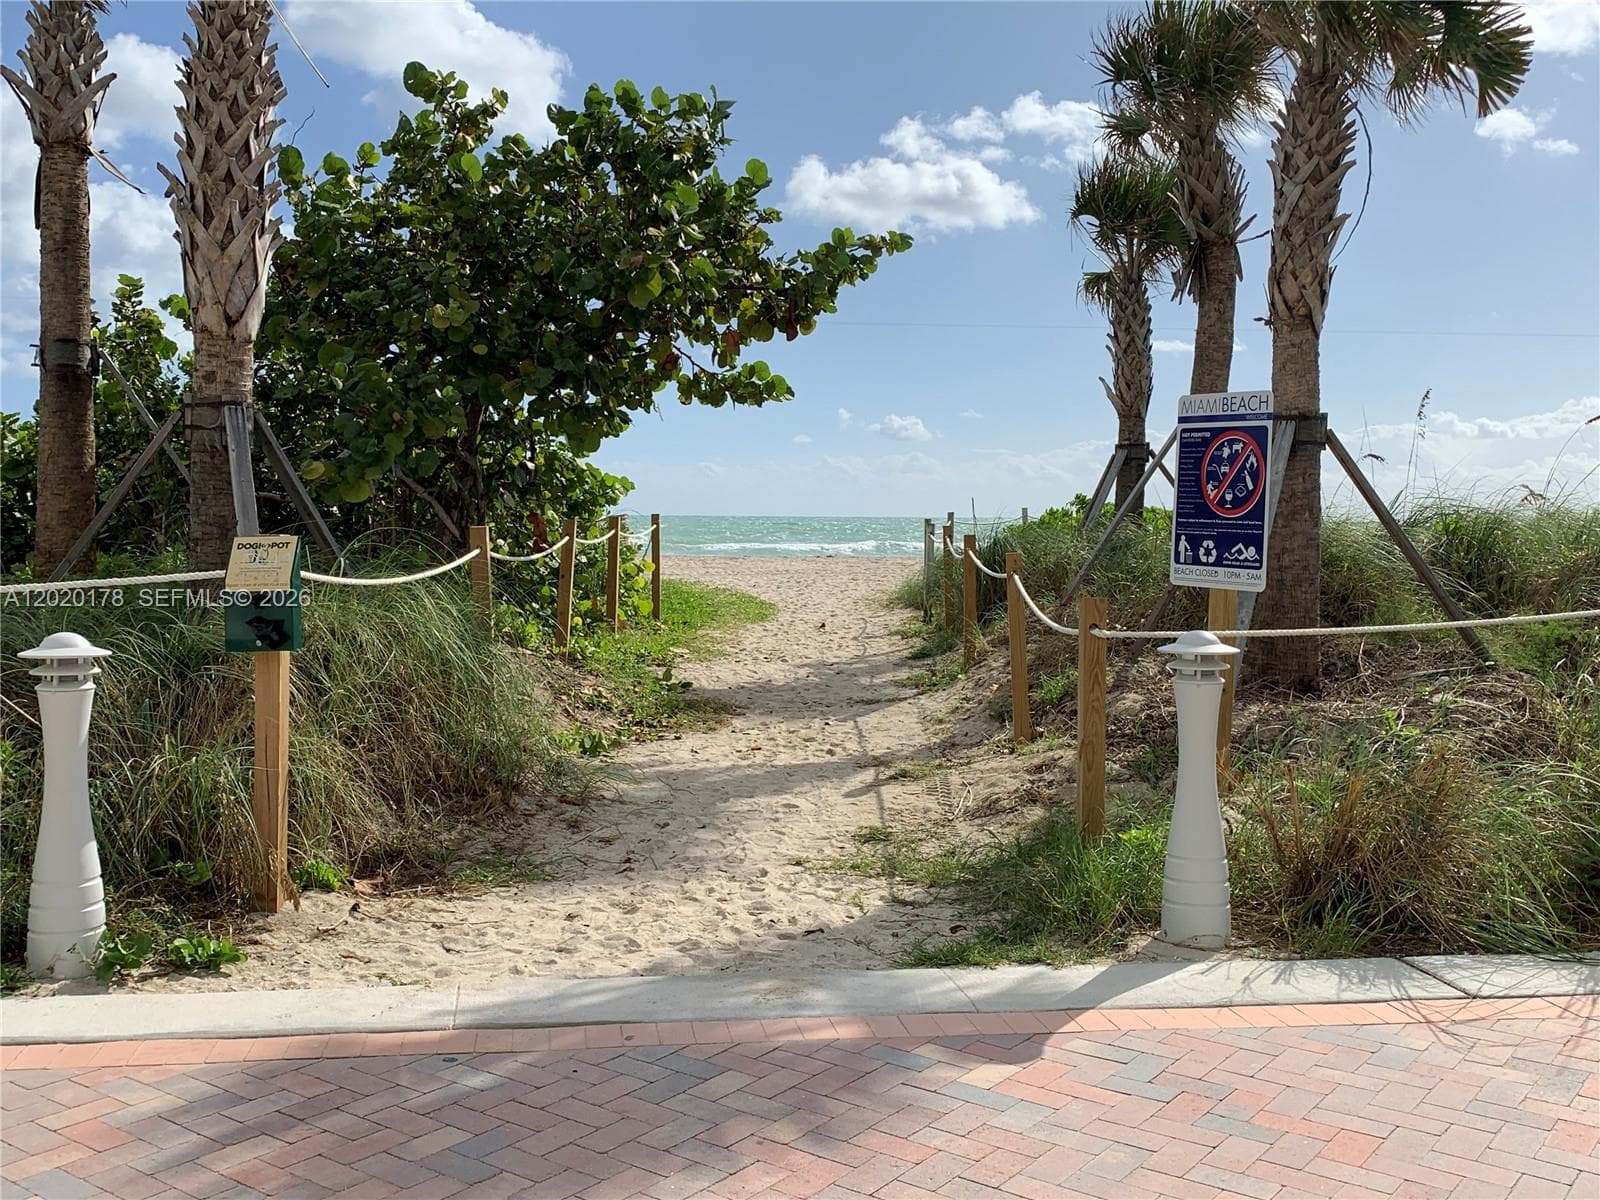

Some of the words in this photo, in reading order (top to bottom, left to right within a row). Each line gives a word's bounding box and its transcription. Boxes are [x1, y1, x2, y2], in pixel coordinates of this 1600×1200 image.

[1182, 395, 1268, 414] MIAMIBEACH
[1174, 567, 1194, 576] BEACH
[1194, 568, 1219, 578] CLOSED
[1223, 570, 1241, 579] 10PM
[1246, 572, 1262, 581] 5AM
